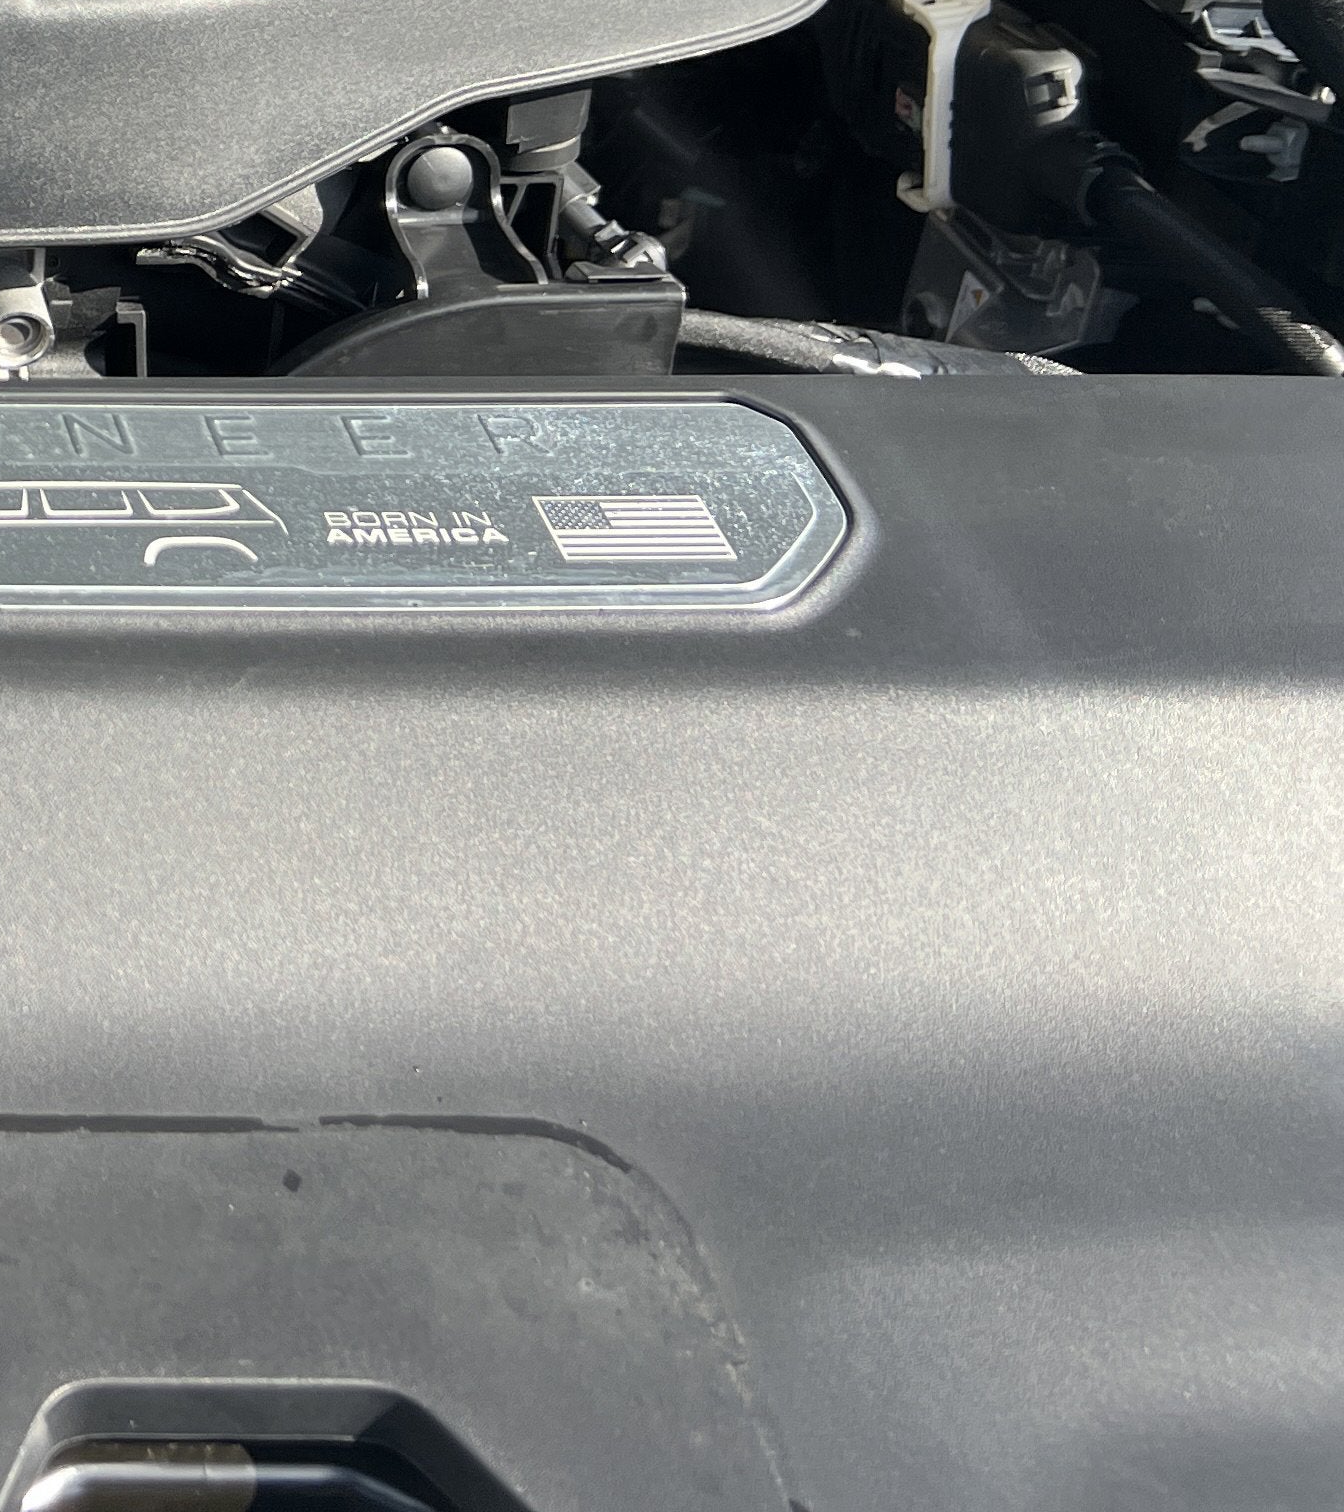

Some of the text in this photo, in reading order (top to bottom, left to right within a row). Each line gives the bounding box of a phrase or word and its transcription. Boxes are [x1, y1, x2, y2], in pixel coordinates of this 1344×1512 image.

[323, 511, 493, 527] BORN IN
[326, 527, 510, 545] AMERICA
